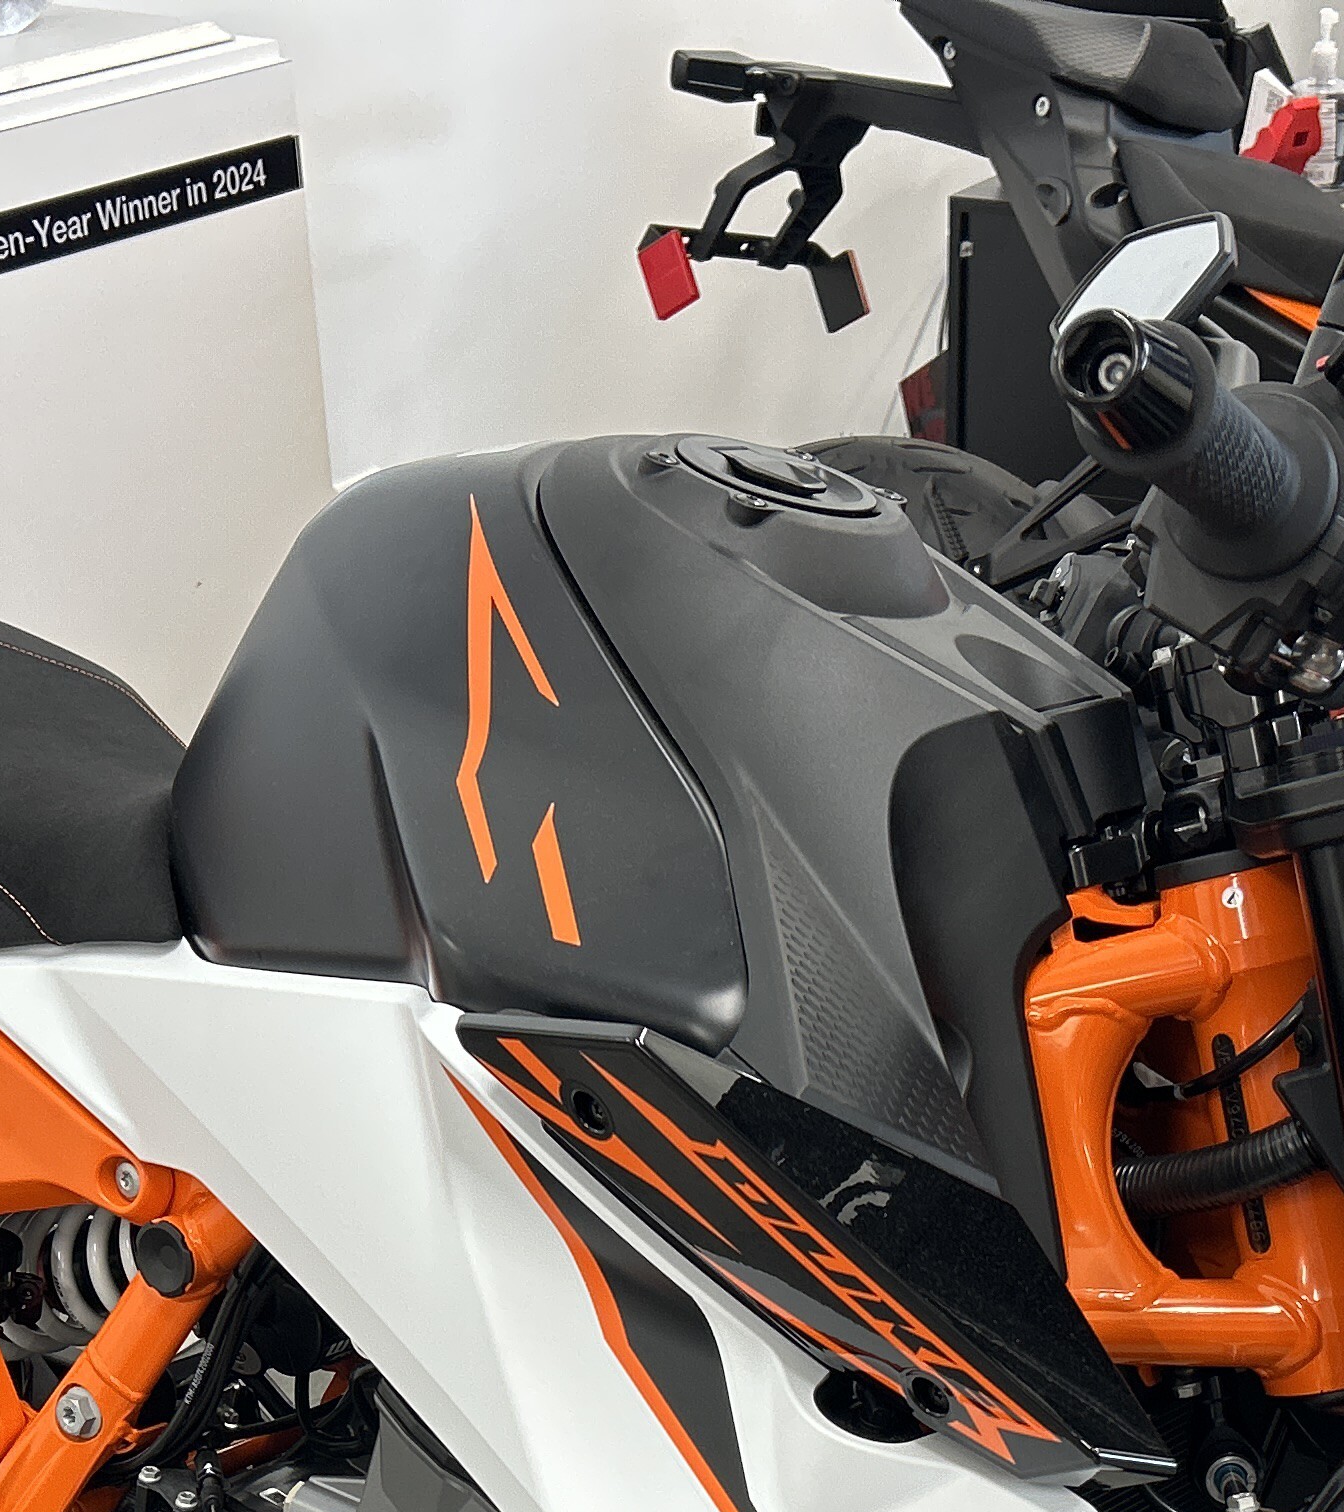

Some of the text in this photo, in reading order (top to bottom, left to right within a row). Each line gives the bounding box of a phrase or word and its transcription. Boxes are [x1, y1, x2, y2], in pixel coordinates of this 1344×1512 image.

[95, 186, 180, 231] Winner
[185, 178, 208, 208] in
[212, 158, 268, 199] 2024
